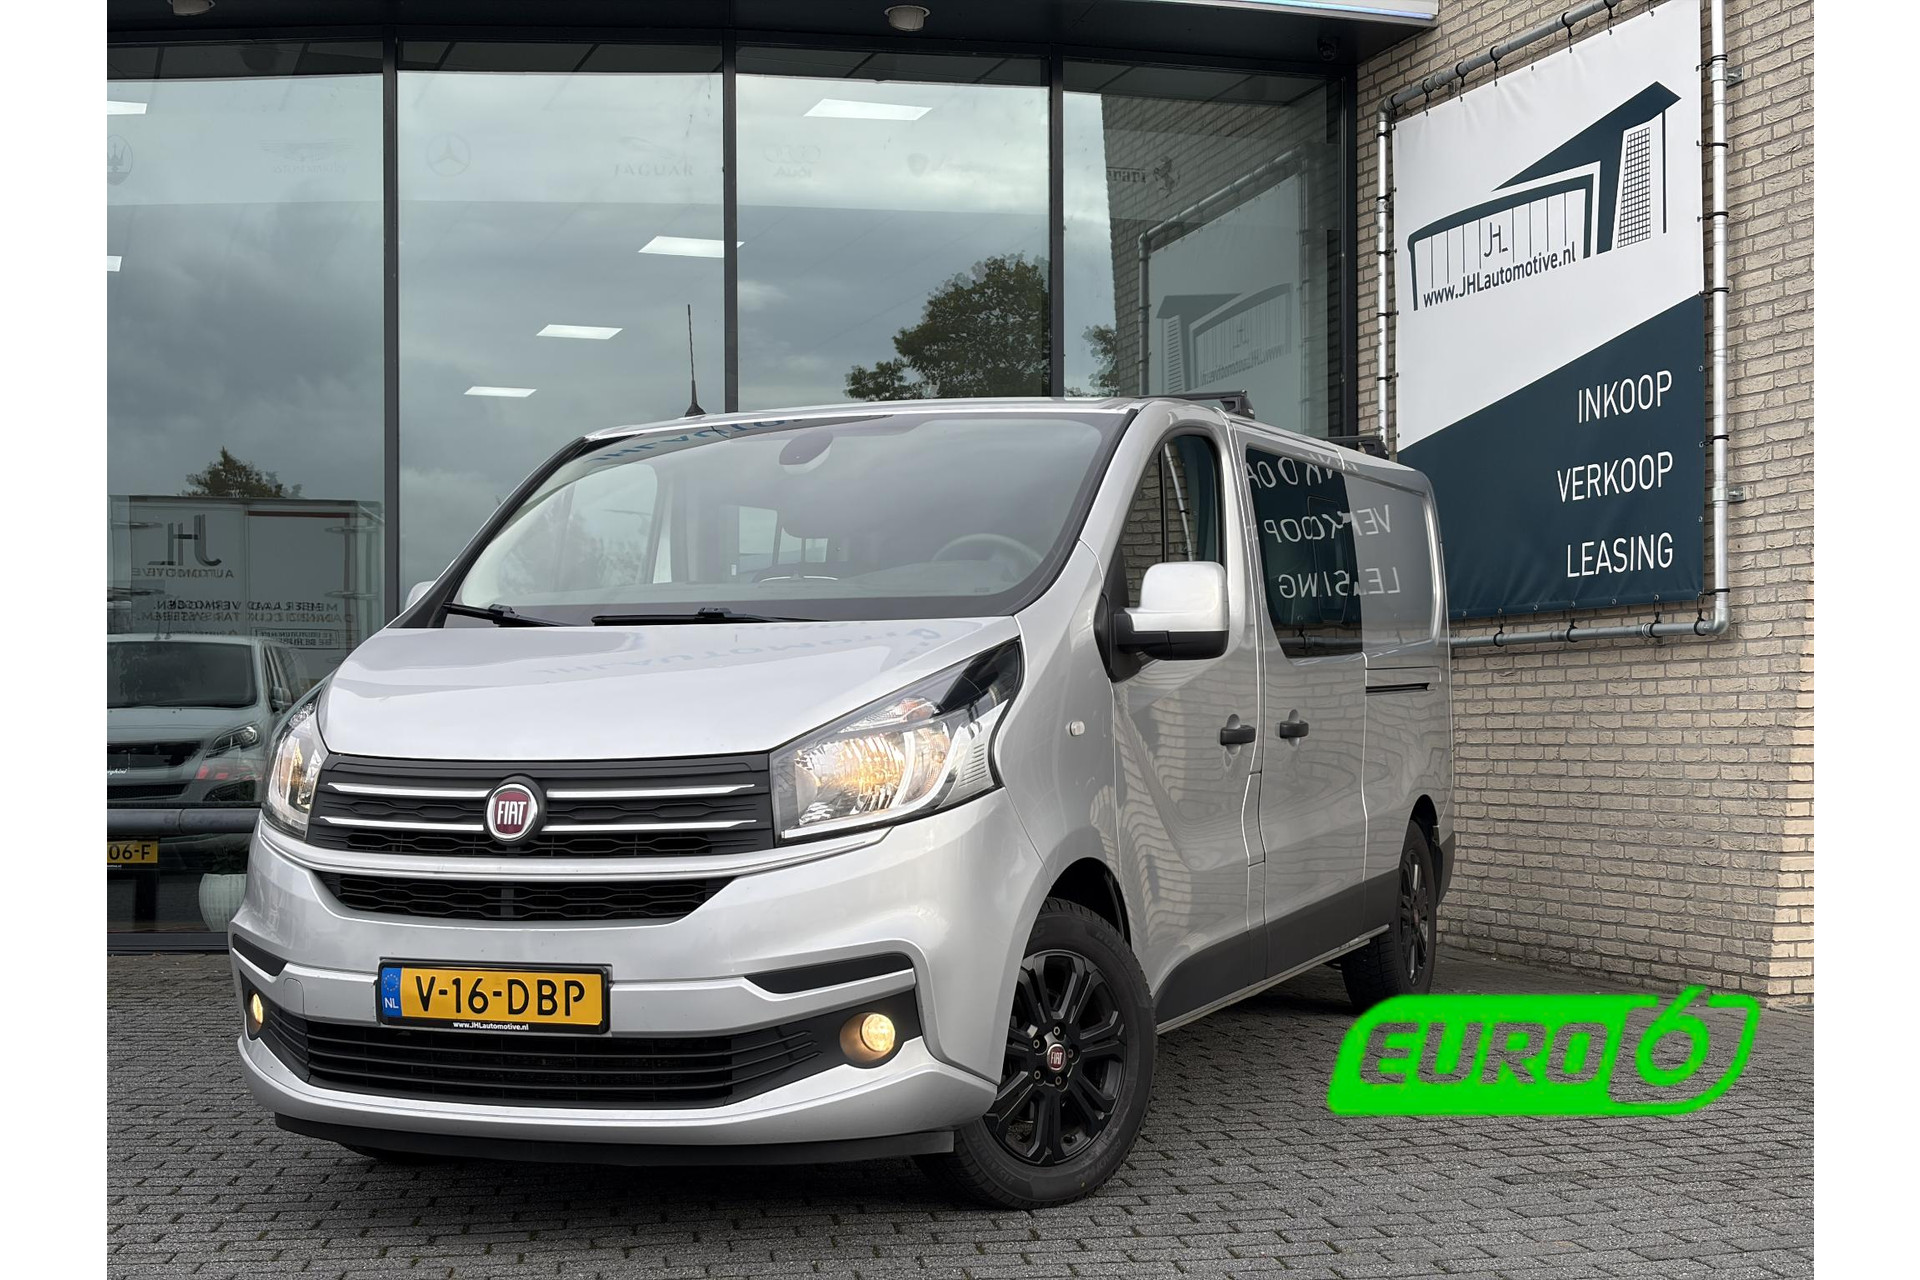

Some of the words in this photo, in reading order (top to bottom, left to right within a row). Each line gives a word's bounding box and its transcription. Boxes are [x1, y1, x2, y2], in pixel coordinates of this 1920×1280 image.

[1484, 222, 1508, 257] JHL
[1423, 241, 1576, 308] www.JHLautomotive.nl
[1578, 370, 1673, 423] INKOOP
[1557, 451, 1673, 502] VERKOOP
[1566, 532, 1673, 577] LEASING
[497, 801, 527, 825] FIAT
[384, 997, 400, 1009] NL
[415, 975, 585, 1017] V-16-DBP
[453, 1021, 530, 1032] www.JHLautomotive.nl
[1050, 1051, 1064, 1065] FIAT
